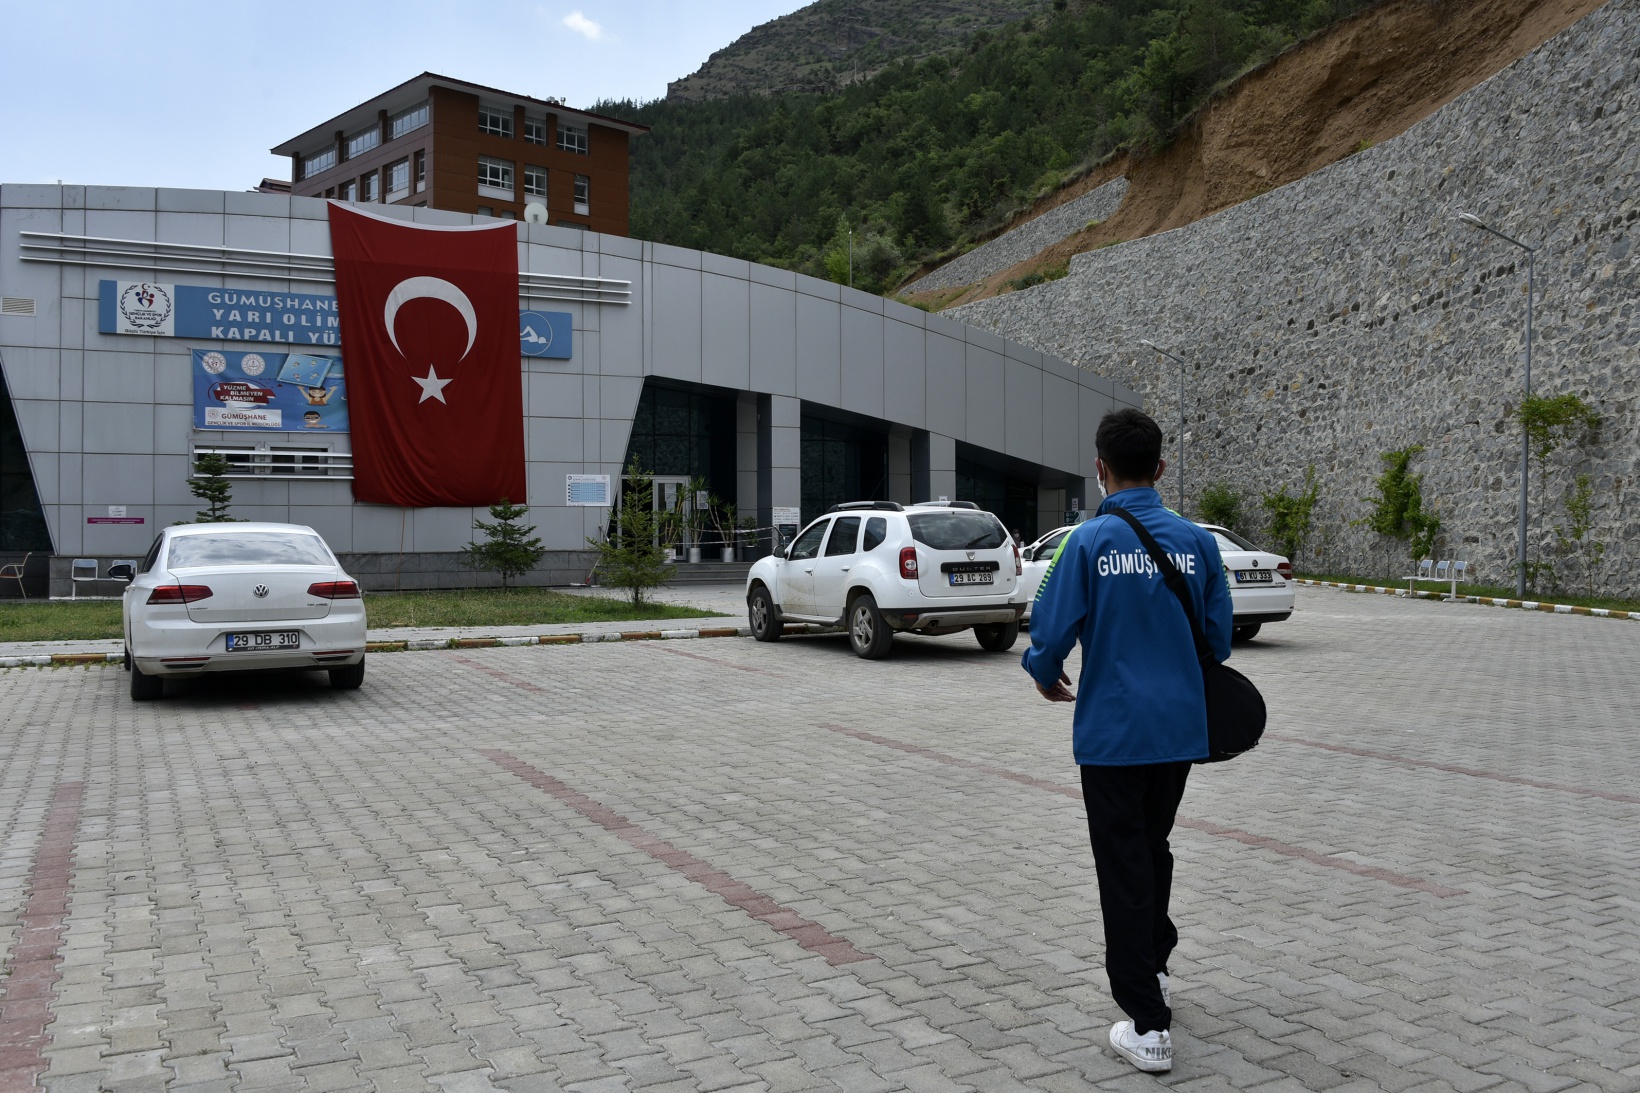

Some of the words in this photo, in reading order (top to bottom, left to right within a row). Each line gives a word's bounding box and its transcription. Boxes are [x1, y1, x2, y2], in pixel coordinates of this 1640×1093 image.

[208, 290, 339, 311] GÜMÜŞHANE
[212, 308, 272, 324] YARI
[211, 326, 294, 342] KAPALI
[221, 412, 268, 421] GÜMÜŞHANE
[1097, 548, 1196, 579] GÜMÜŞNE
[954, 574, 964, 582] 29
[967, 573, 976, 582] AC
[979, 573, 992, 582] 289
[1259, 571, 1271, 580] 333
[234, 635, 249, 647] 29
[254, 633, 272, 646] DB
[278, 633, 298, 645] 310
